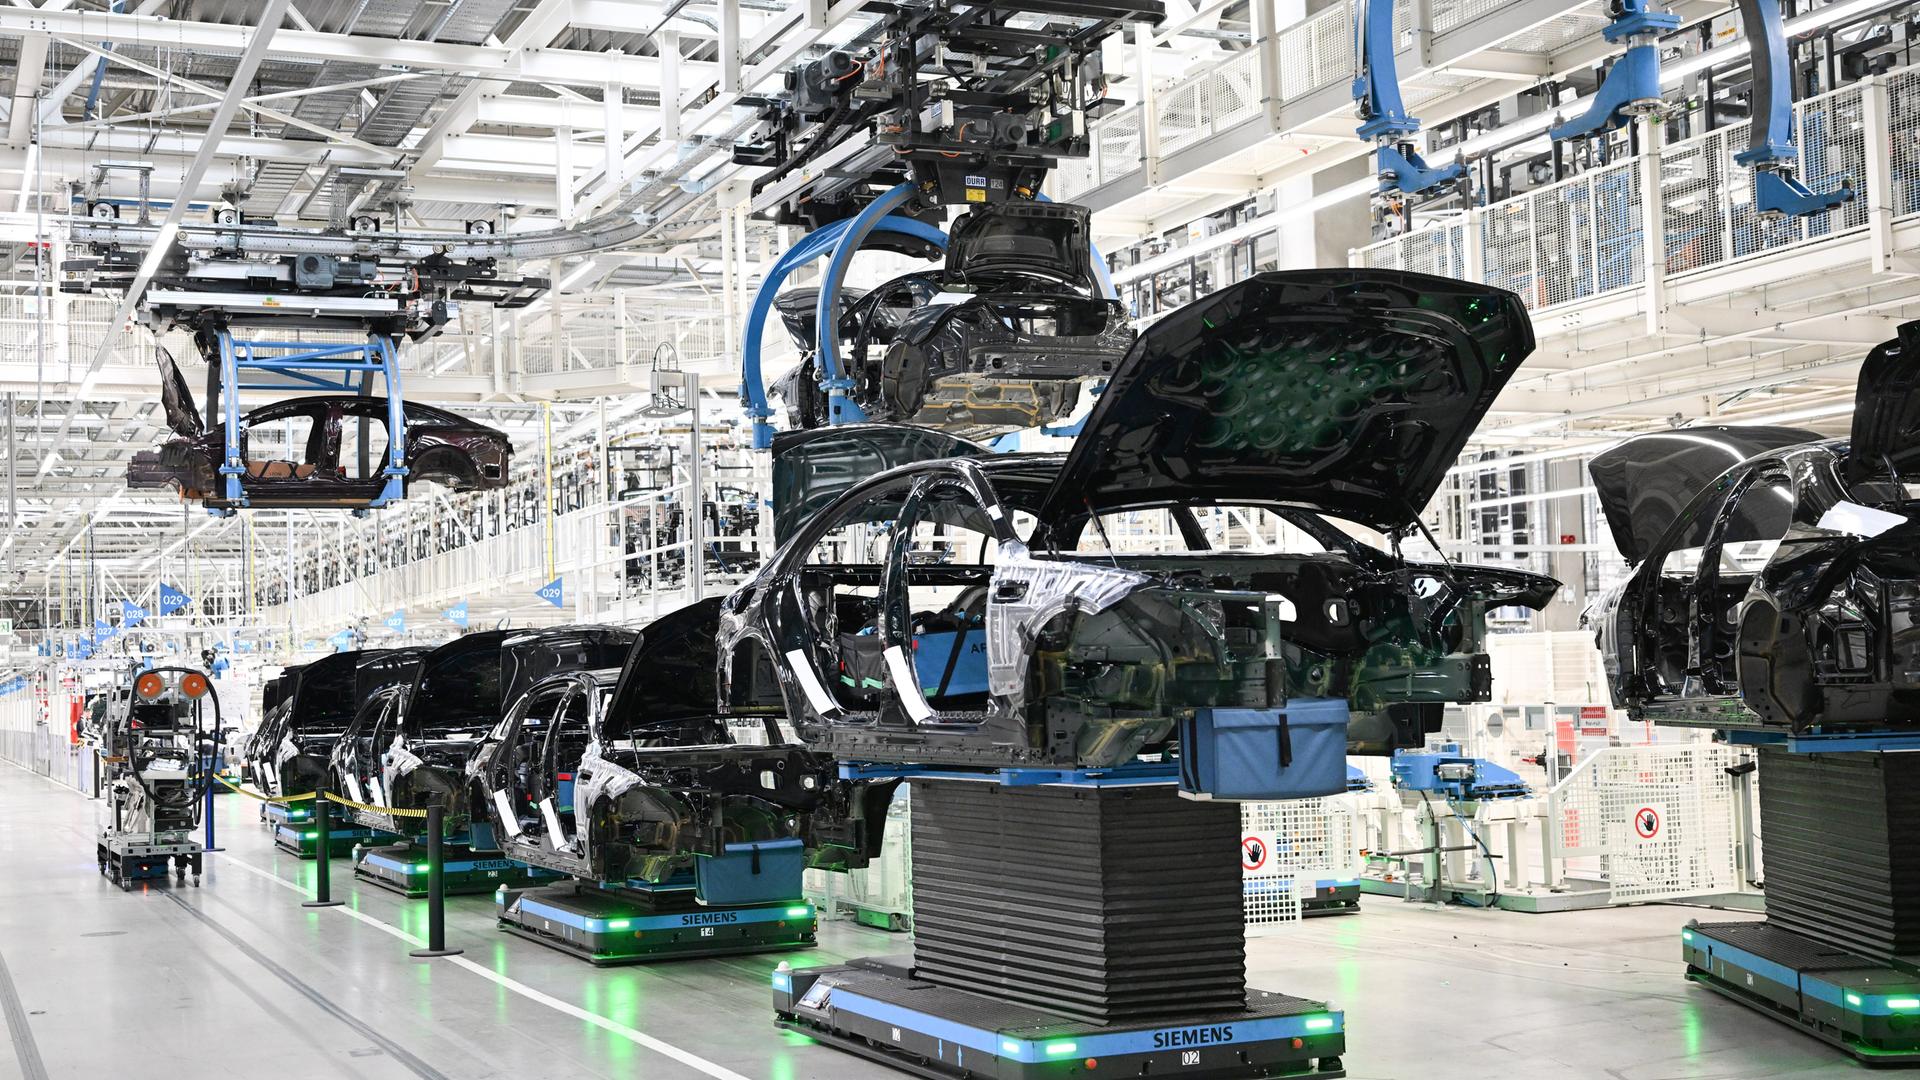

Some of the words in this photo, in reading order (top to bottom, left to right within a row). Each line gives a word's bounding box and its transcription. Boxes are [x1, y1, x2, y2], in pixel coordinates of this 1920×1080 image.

[543, 588, 560, 598] 029
[163, 595, 183, 605] 029
[126, 610, 144, 618] 028
[449, 610, 465, 618] 028
[387, 618, 401, 626] 027
[97, 627, 112, 635] 027
[473, 860, 515, 869] SIEMENS
[682, 912, 737, 926] SIEMENS
[701, 927, 714, 937] 14
[1153, 1025, 1233, 1048] SIEMENS
[1183, 1051, 1199, 1065] 02
